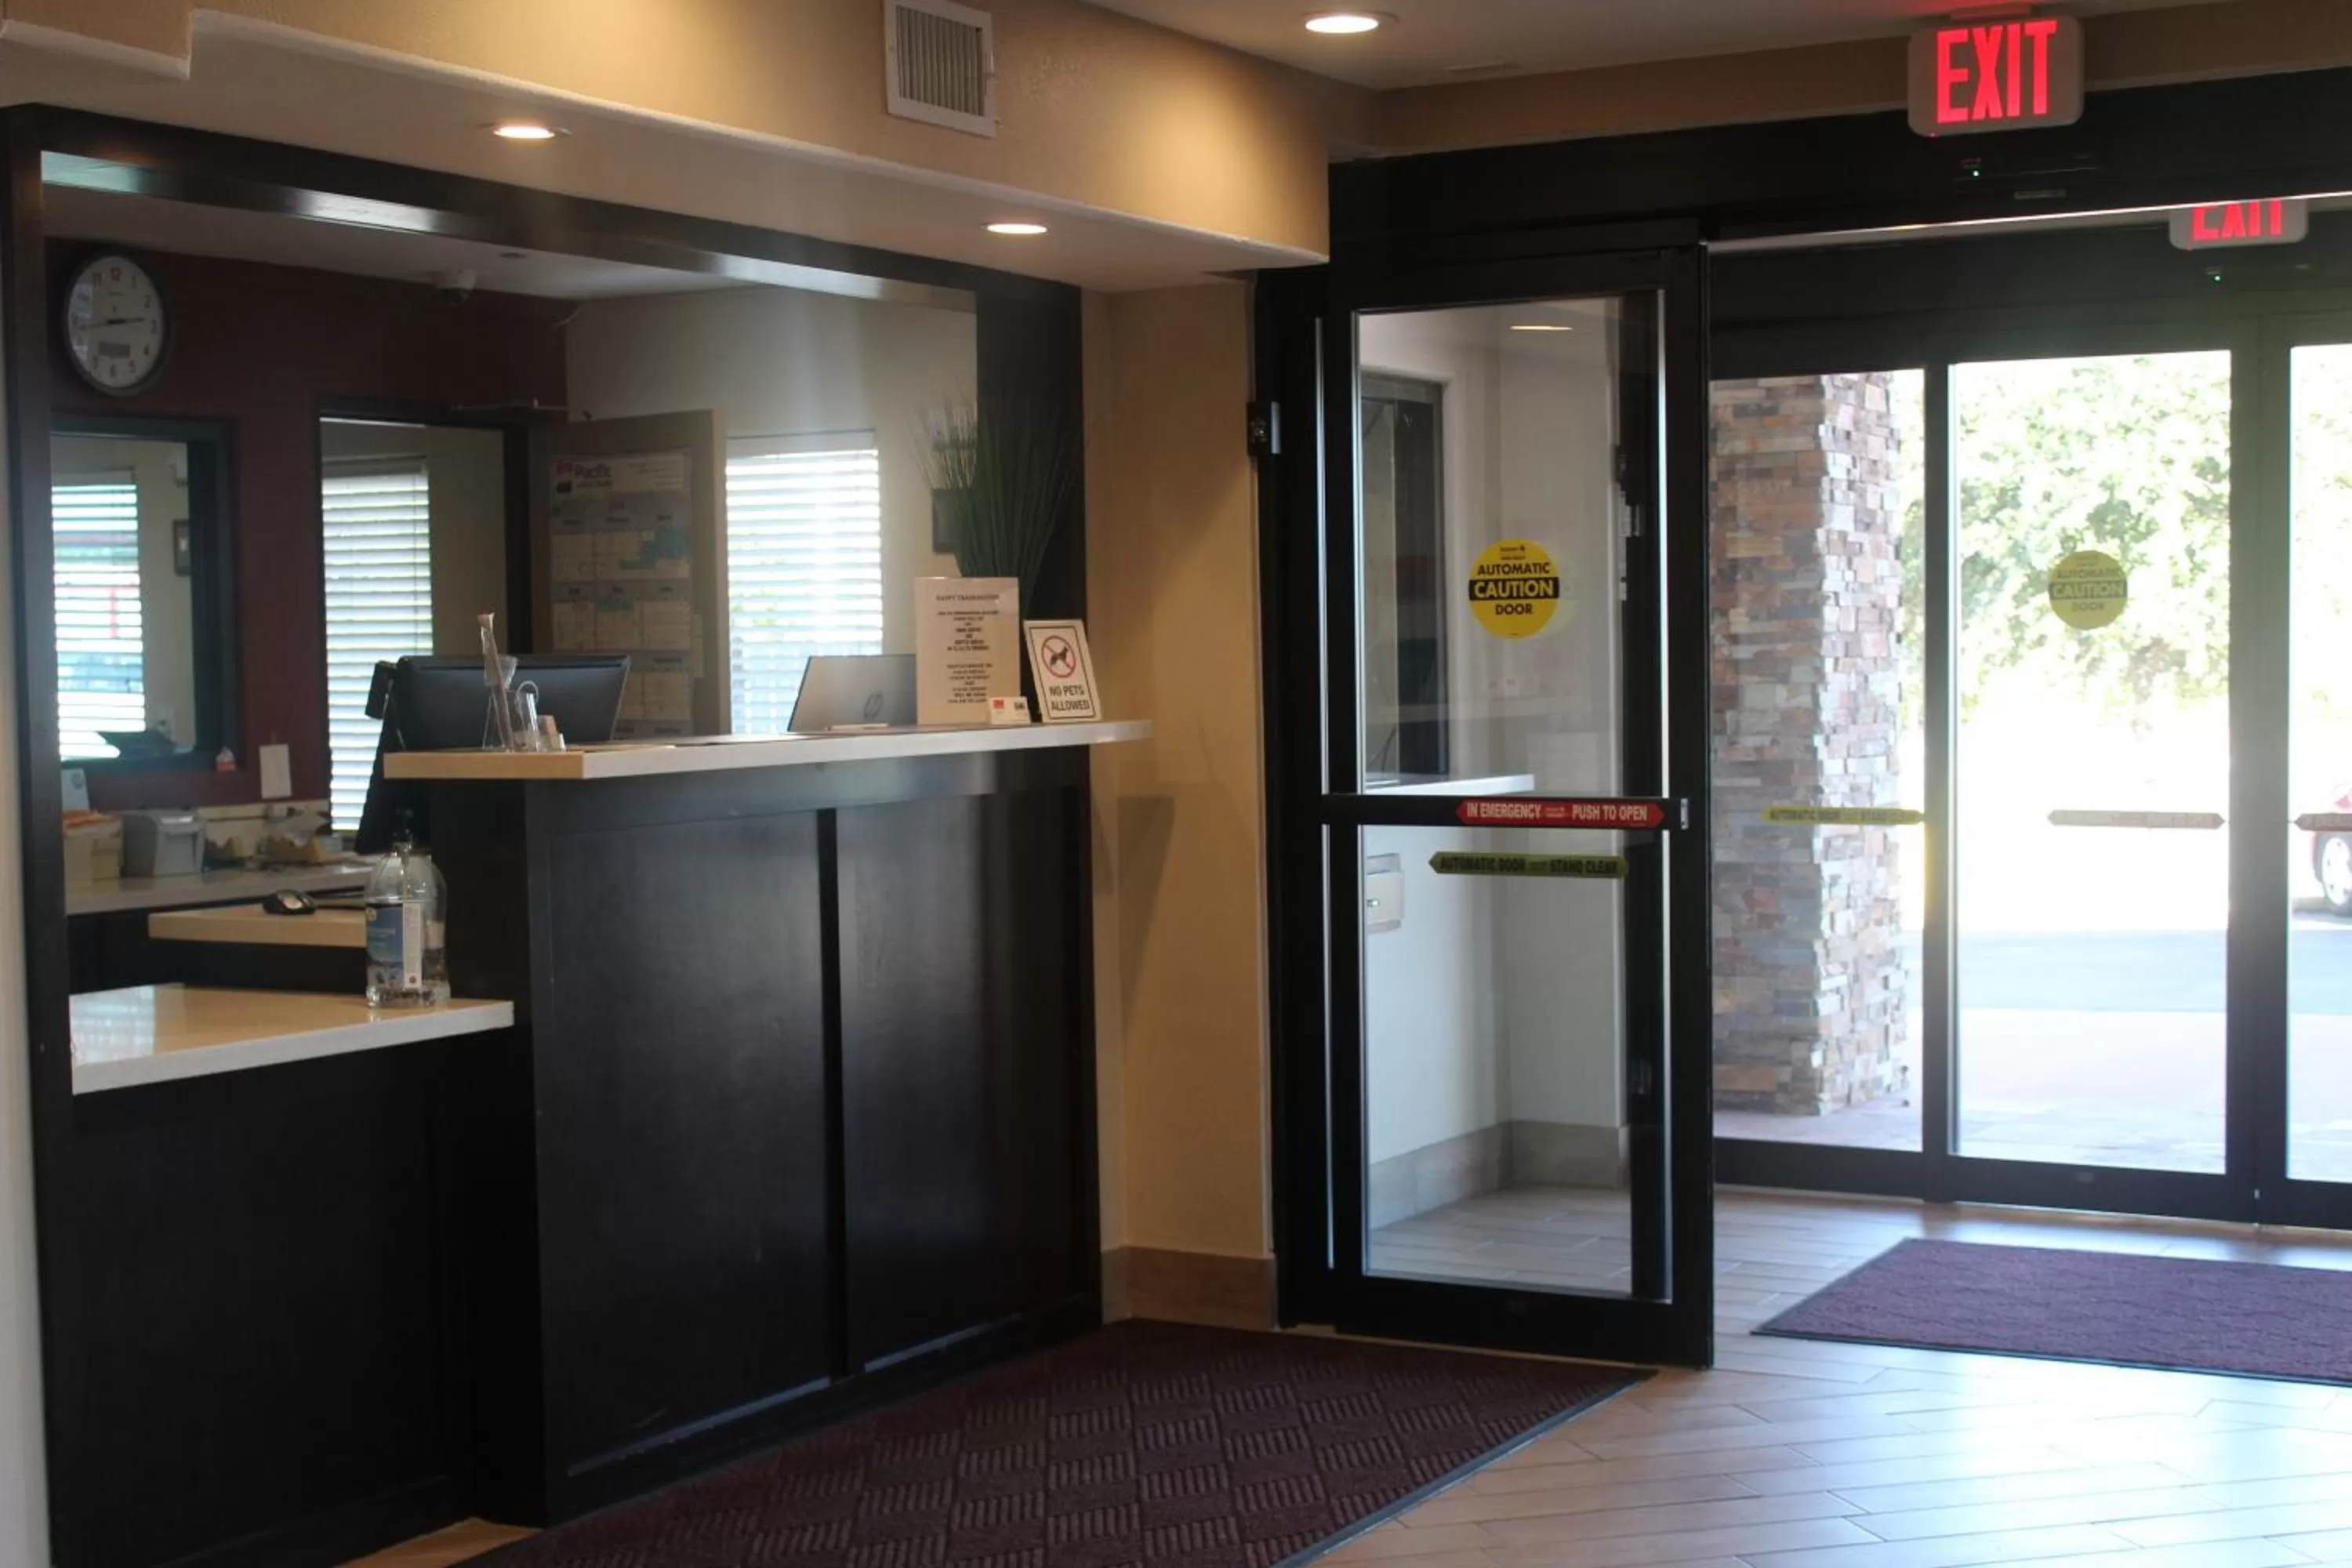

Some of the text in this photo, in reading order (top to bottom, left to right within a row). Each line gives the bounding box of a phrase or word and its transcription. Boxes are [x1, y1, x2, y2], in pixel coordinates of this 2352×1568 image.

[1936, 19, 2058, 124] EXIT
[1478, 562, 1551, 576] AUTOMATIC
[1475, 579, 1554, 598] CAUTION
[1495, 603, 1533, 615] DOOR
[1049, 684, 1085, 696] NO PETS
[1051, 699, 1090, 711] ALLOWED
[1466, 802, 1478, 817] IN
[1479, 802, 1541, 818] EMERGENCY
[1571, 804, 1600, 820] PUSH
[1602, 805, 1617, 821] TO
[1618, 805, 1648, 822] OPEN
[1440, 856, 1497, 871] AUTOMATIC
[1498, 858, 1526, 872] DOOR
[1550, 858, 1584, 873] STAND
[1585, 859, 1618, 874] CLEAR
